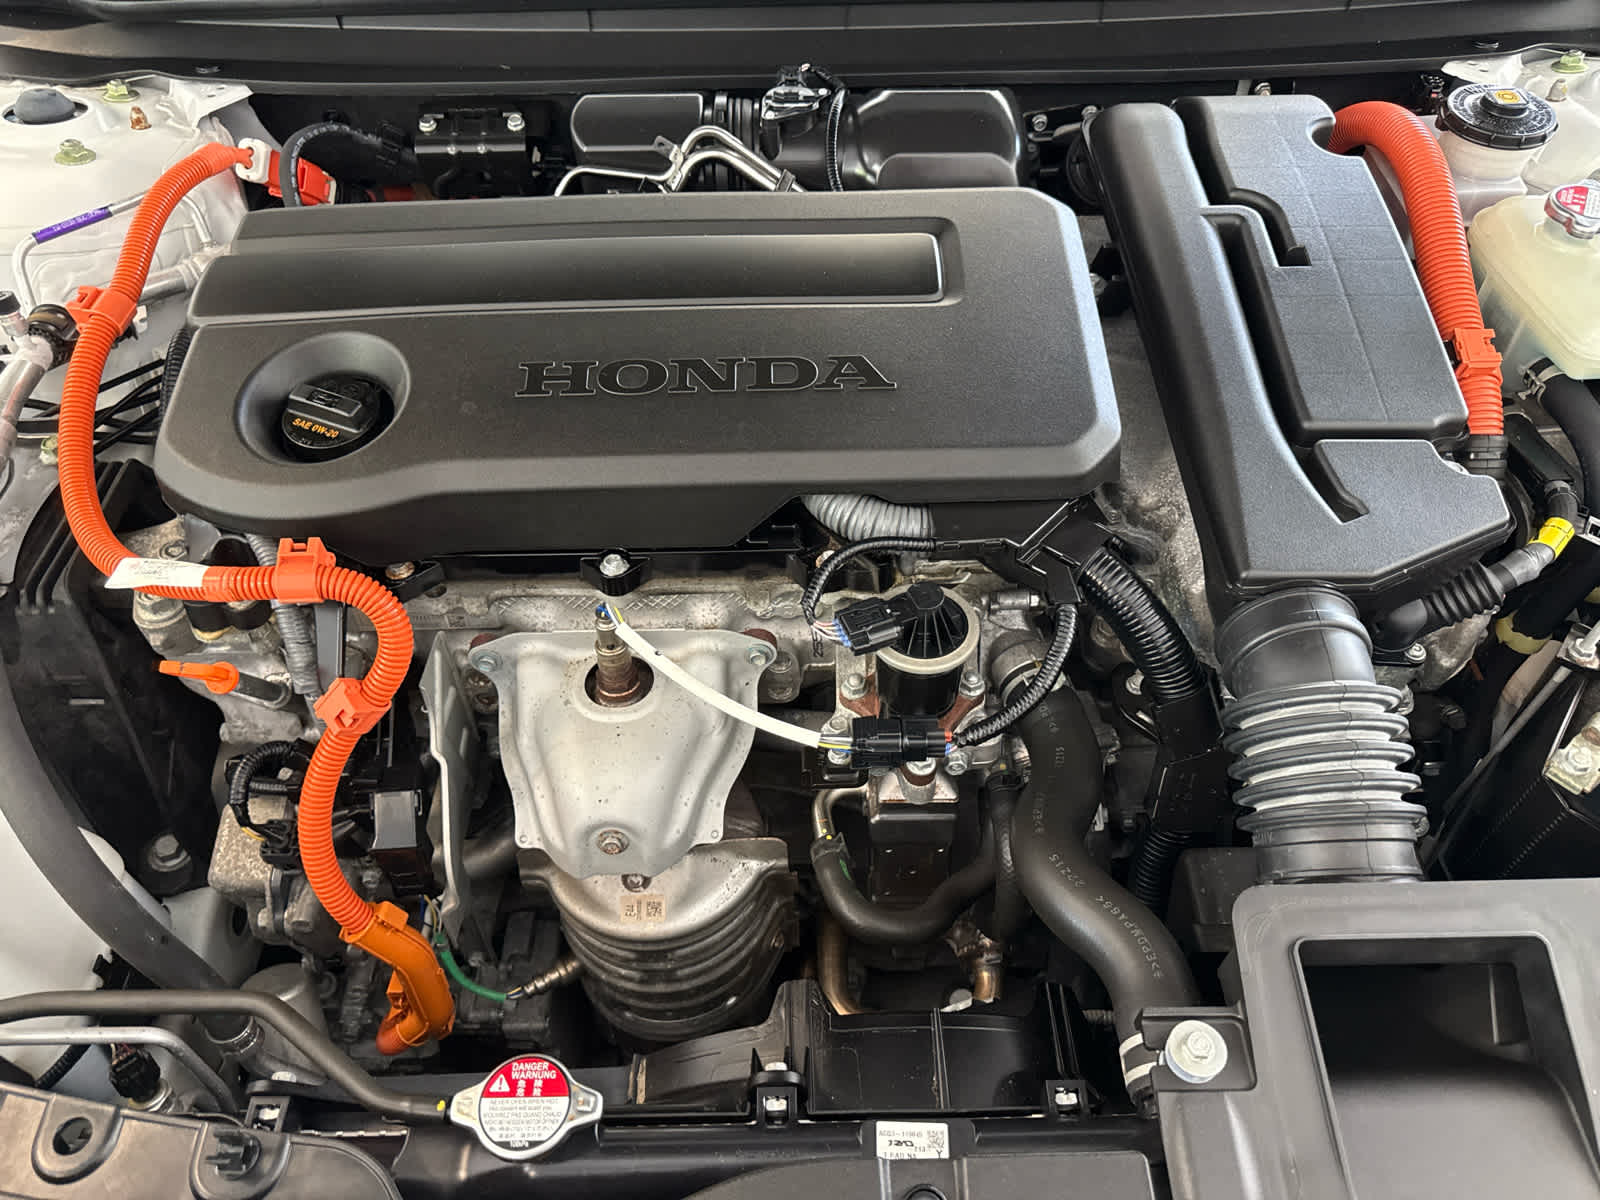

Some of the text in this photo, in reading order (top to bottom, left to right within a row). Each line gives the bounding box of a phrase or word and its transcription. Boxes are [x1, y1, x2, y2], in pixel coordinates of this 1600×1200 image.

[514, 354, 898, 398] HONDA
[292, 418, 340, 439] SAE 0W-20
[512, 1062, 549, 1071] DANGER
[511, 1070, 557, 1080] WARNUNG
